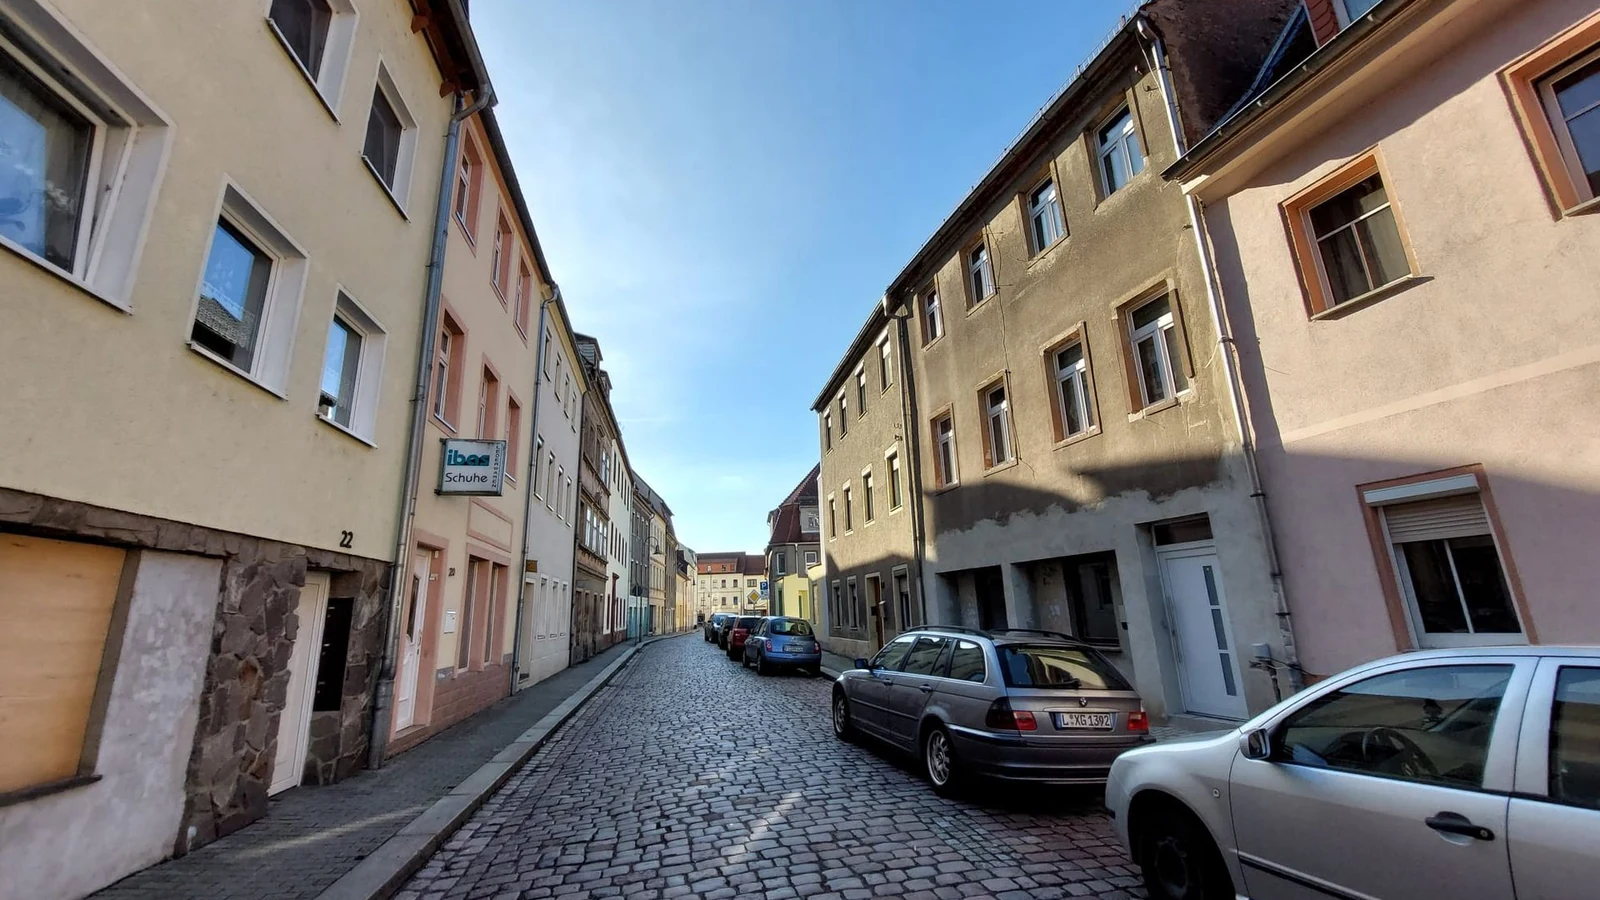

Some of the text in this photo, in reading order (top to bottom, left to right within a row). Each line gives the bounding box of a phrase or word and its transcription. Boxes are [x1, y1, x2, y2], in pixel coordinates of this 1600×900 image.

[445, 472, 488, 483] Schuhe
[340, 530, 353, 548] 22
[761, 582, 767, 590] P
[1075, 714, 1087, 726] XG
[1088, 715, 1110, 727] 1392
